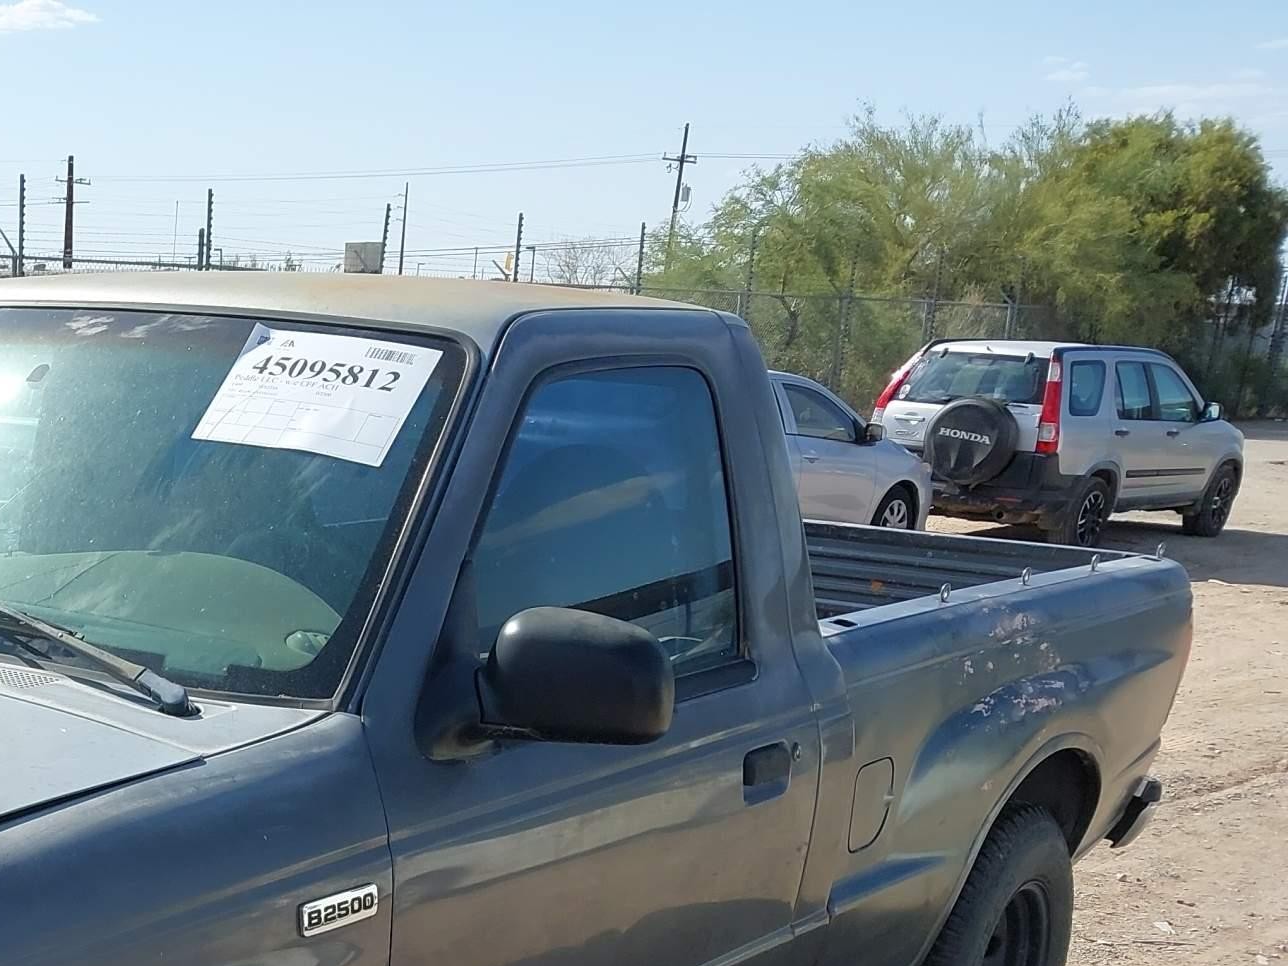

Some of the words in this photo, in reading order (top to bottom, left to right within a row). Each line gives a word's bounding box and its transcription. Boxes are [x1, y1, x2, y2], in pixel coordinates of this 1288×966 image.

[252, 354, 401, 393] 45095812
[938, 427, 991, 445] HONDA
[307, 892, 374, 927] B2500
